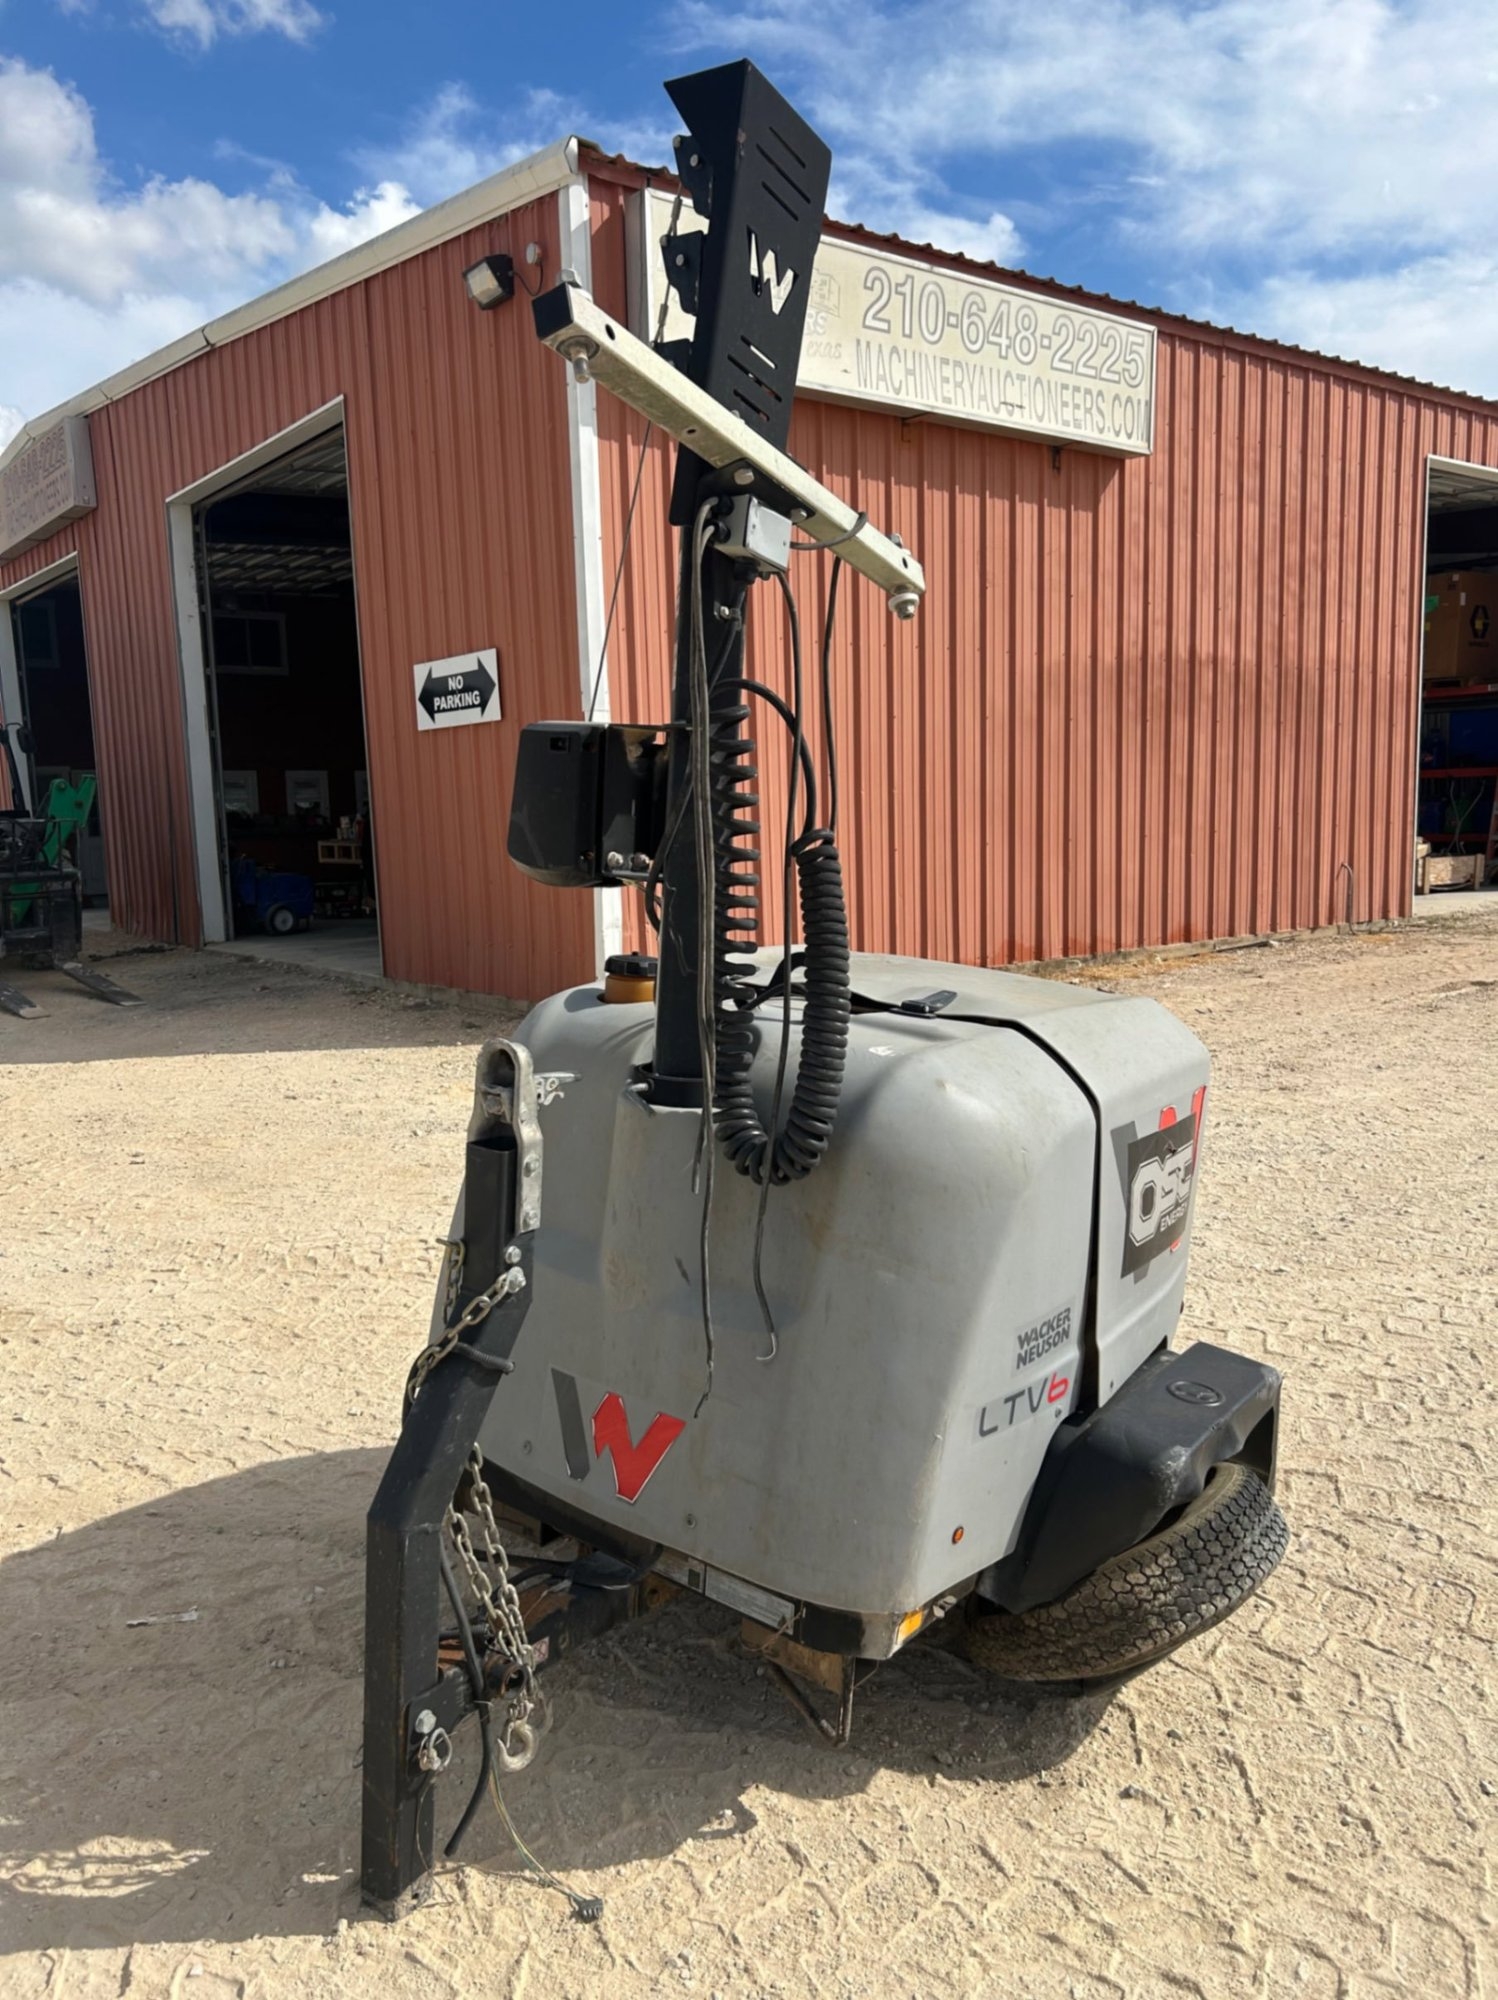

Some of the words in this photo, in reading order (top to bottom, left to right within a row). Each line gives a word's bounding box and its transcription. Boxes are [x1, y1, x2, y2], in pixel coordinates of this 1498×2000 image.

[862, 265, 1146, 388] 210-648-2225
[856, 338, 1149, 442] MACHINERYAUCTIONEERS.COM
[433, 690, 481, 711] PARKING
[448, 675, 464, 691] NO
[1016, 1324, 1071, 1370] NEUSON
[1017, 1307, 1071, 1350] WACKER
